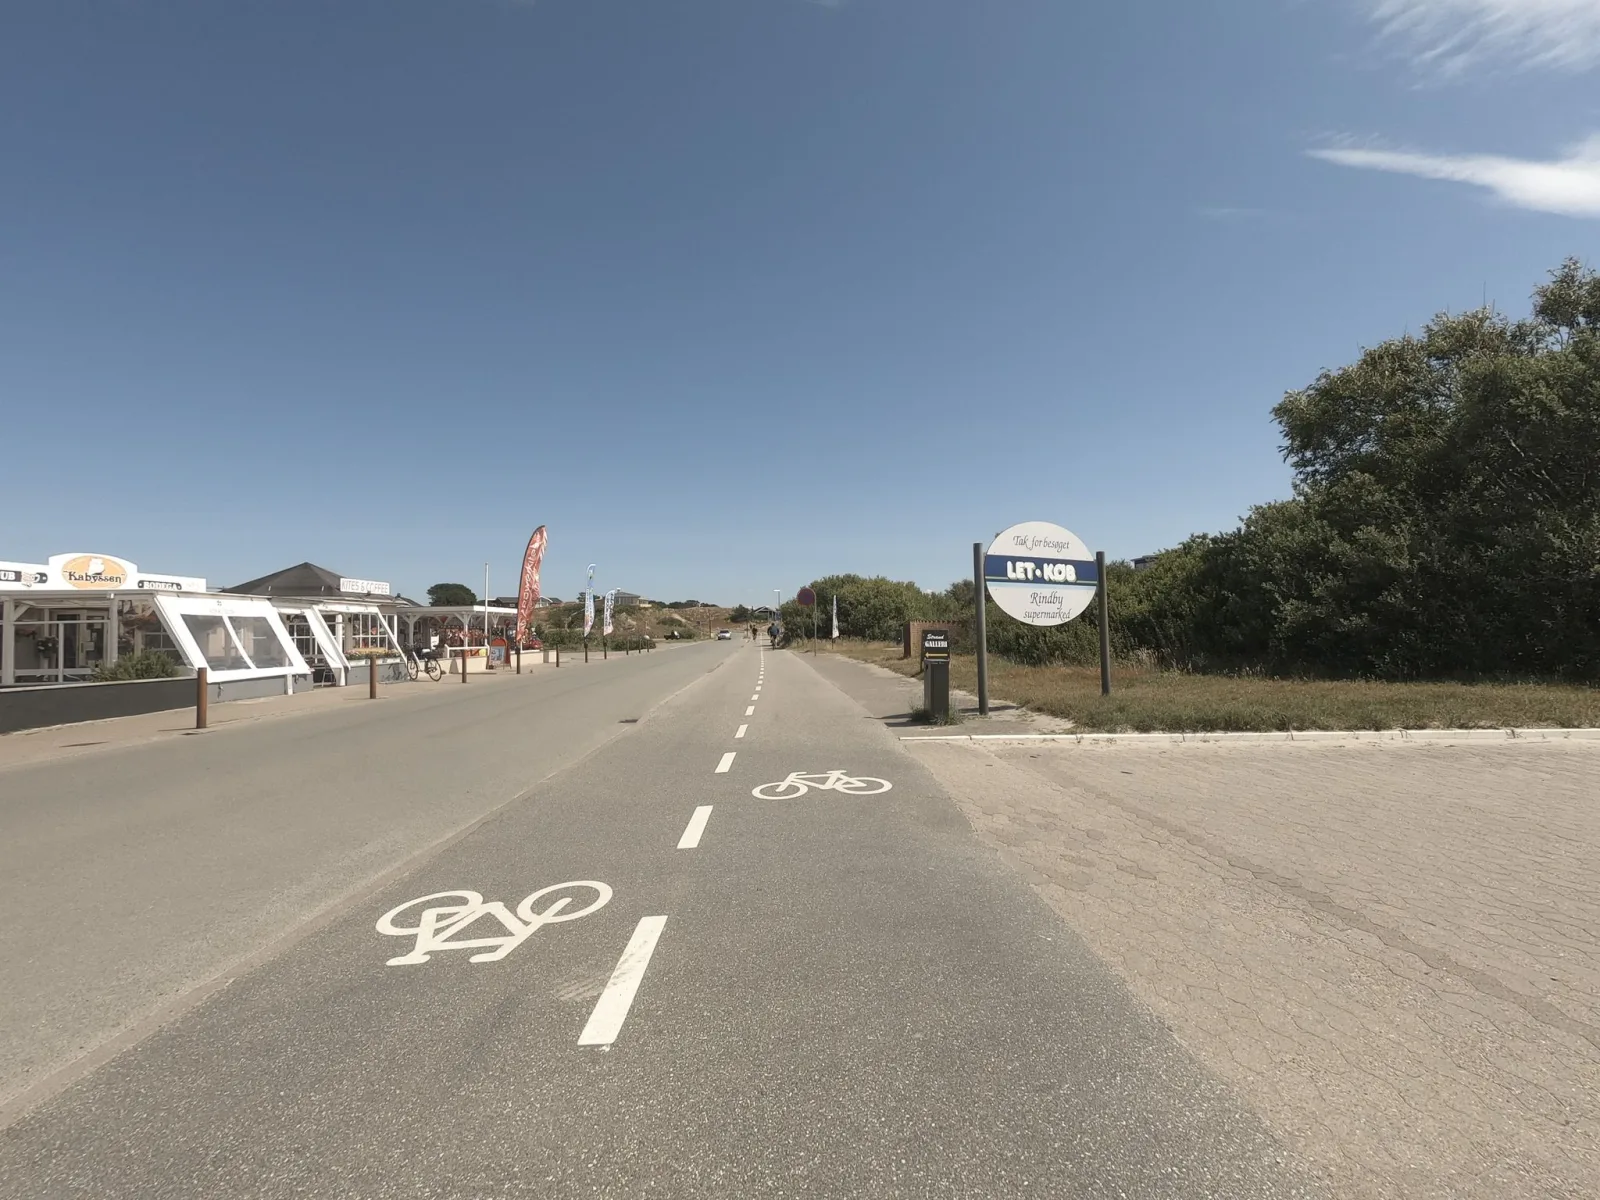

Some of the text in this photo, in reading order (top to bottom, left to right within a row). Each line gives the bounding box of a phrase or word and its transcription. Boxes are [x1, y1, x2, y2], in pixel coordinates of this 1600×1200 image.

[1012, 535, 1070, 552] Tak for besøget
[68, 571, 122, 583] Kabyssen
[143, 582, 176, 591] BODEGA
[342, 580, 359, 590] KITES
[366, 582, 388, 593] COFFEE
[1030, 591, 1064, 610] Rindby
[1023, 608, 1071, 623] supermarked
